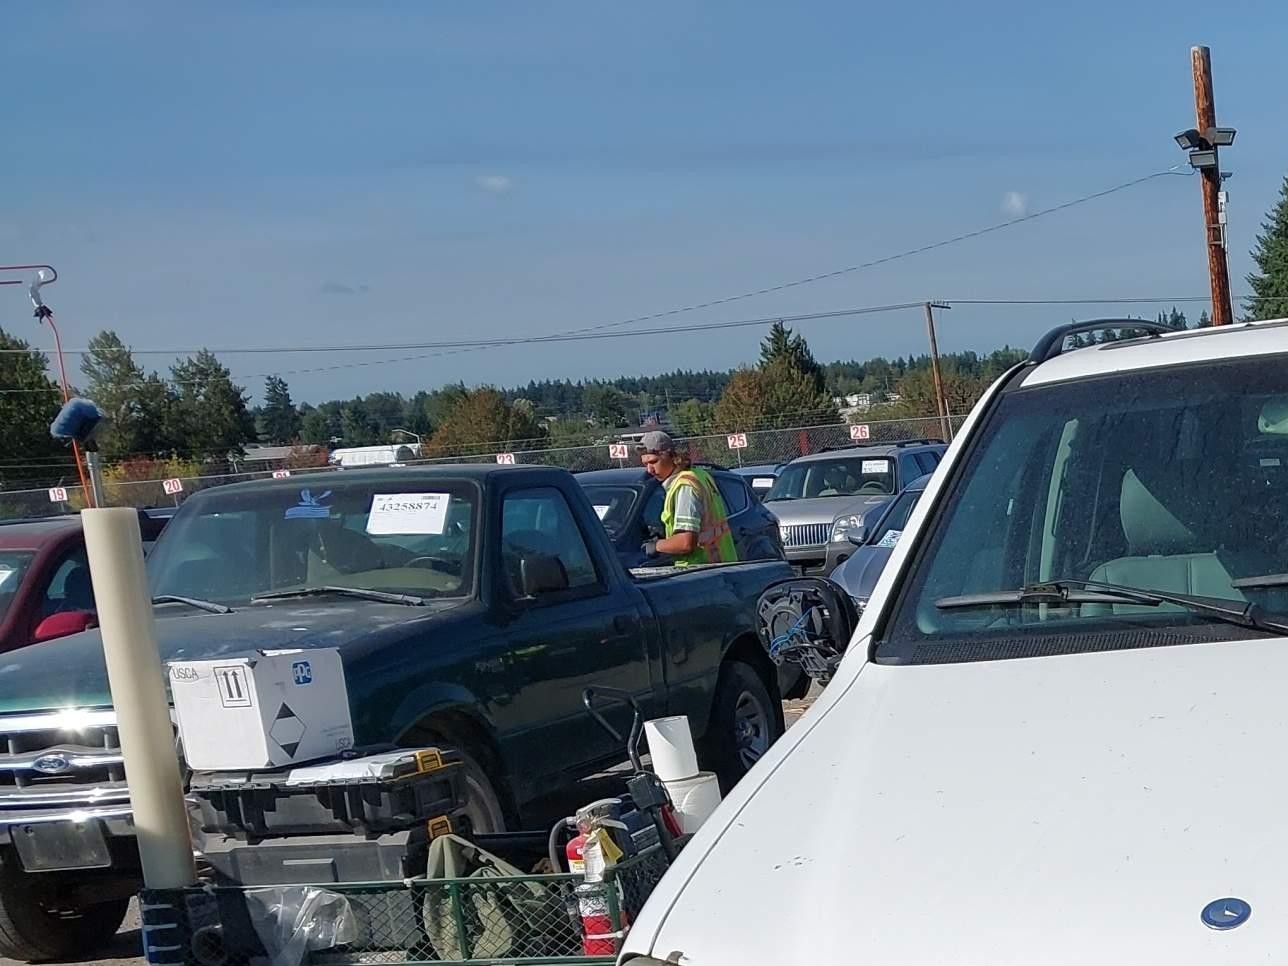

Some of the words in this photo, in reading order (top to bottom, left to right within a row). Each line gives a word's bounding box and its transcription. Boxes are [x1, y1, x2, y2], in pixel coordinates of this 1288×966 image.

[852, 426, 868, 438] 26
[730, 435, 745, 448] 25
[611, 445, 625, 456] 24
[165, 479, 180, 492] 20
[52, 488, 64, 500] 19
[379, 502, 438, 511] 43258874
[171, 667, 199, 679] USCA
[293, 662, 312, 684] PPG
